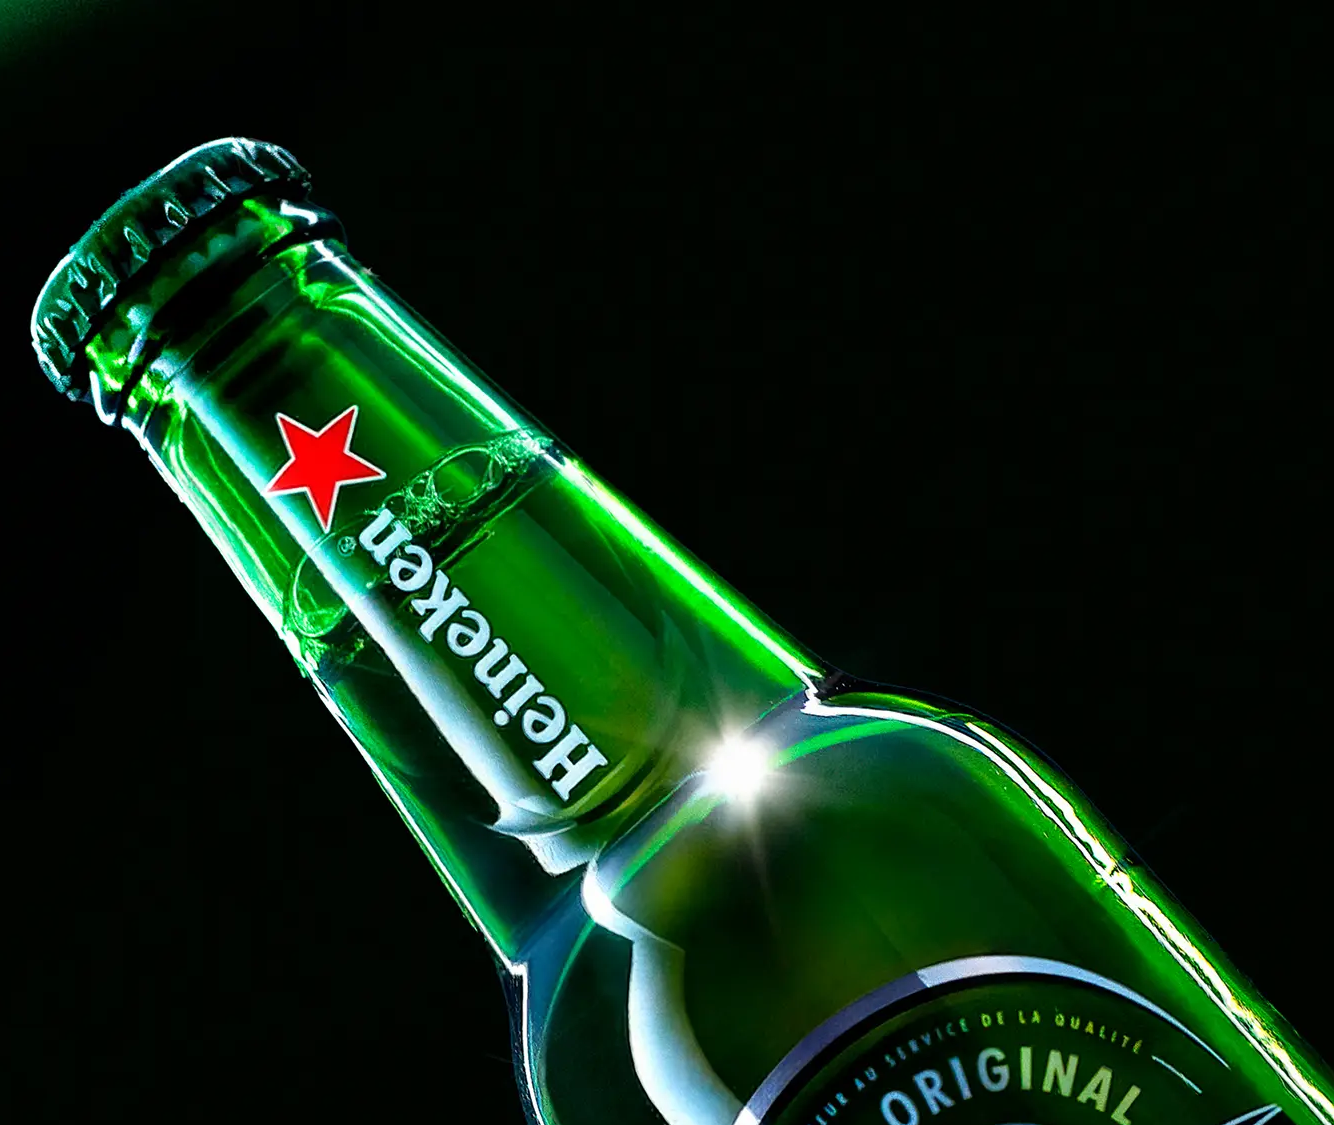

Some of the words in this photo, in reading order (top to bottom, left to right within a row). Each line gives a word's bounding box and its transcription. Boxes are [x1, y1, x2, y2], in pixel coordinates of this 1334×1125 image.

[357, 509, 609, 802] Heineken
[980, 1010, 1005, 1028] DE
[1018, 1009, 1042, 1025] LA
